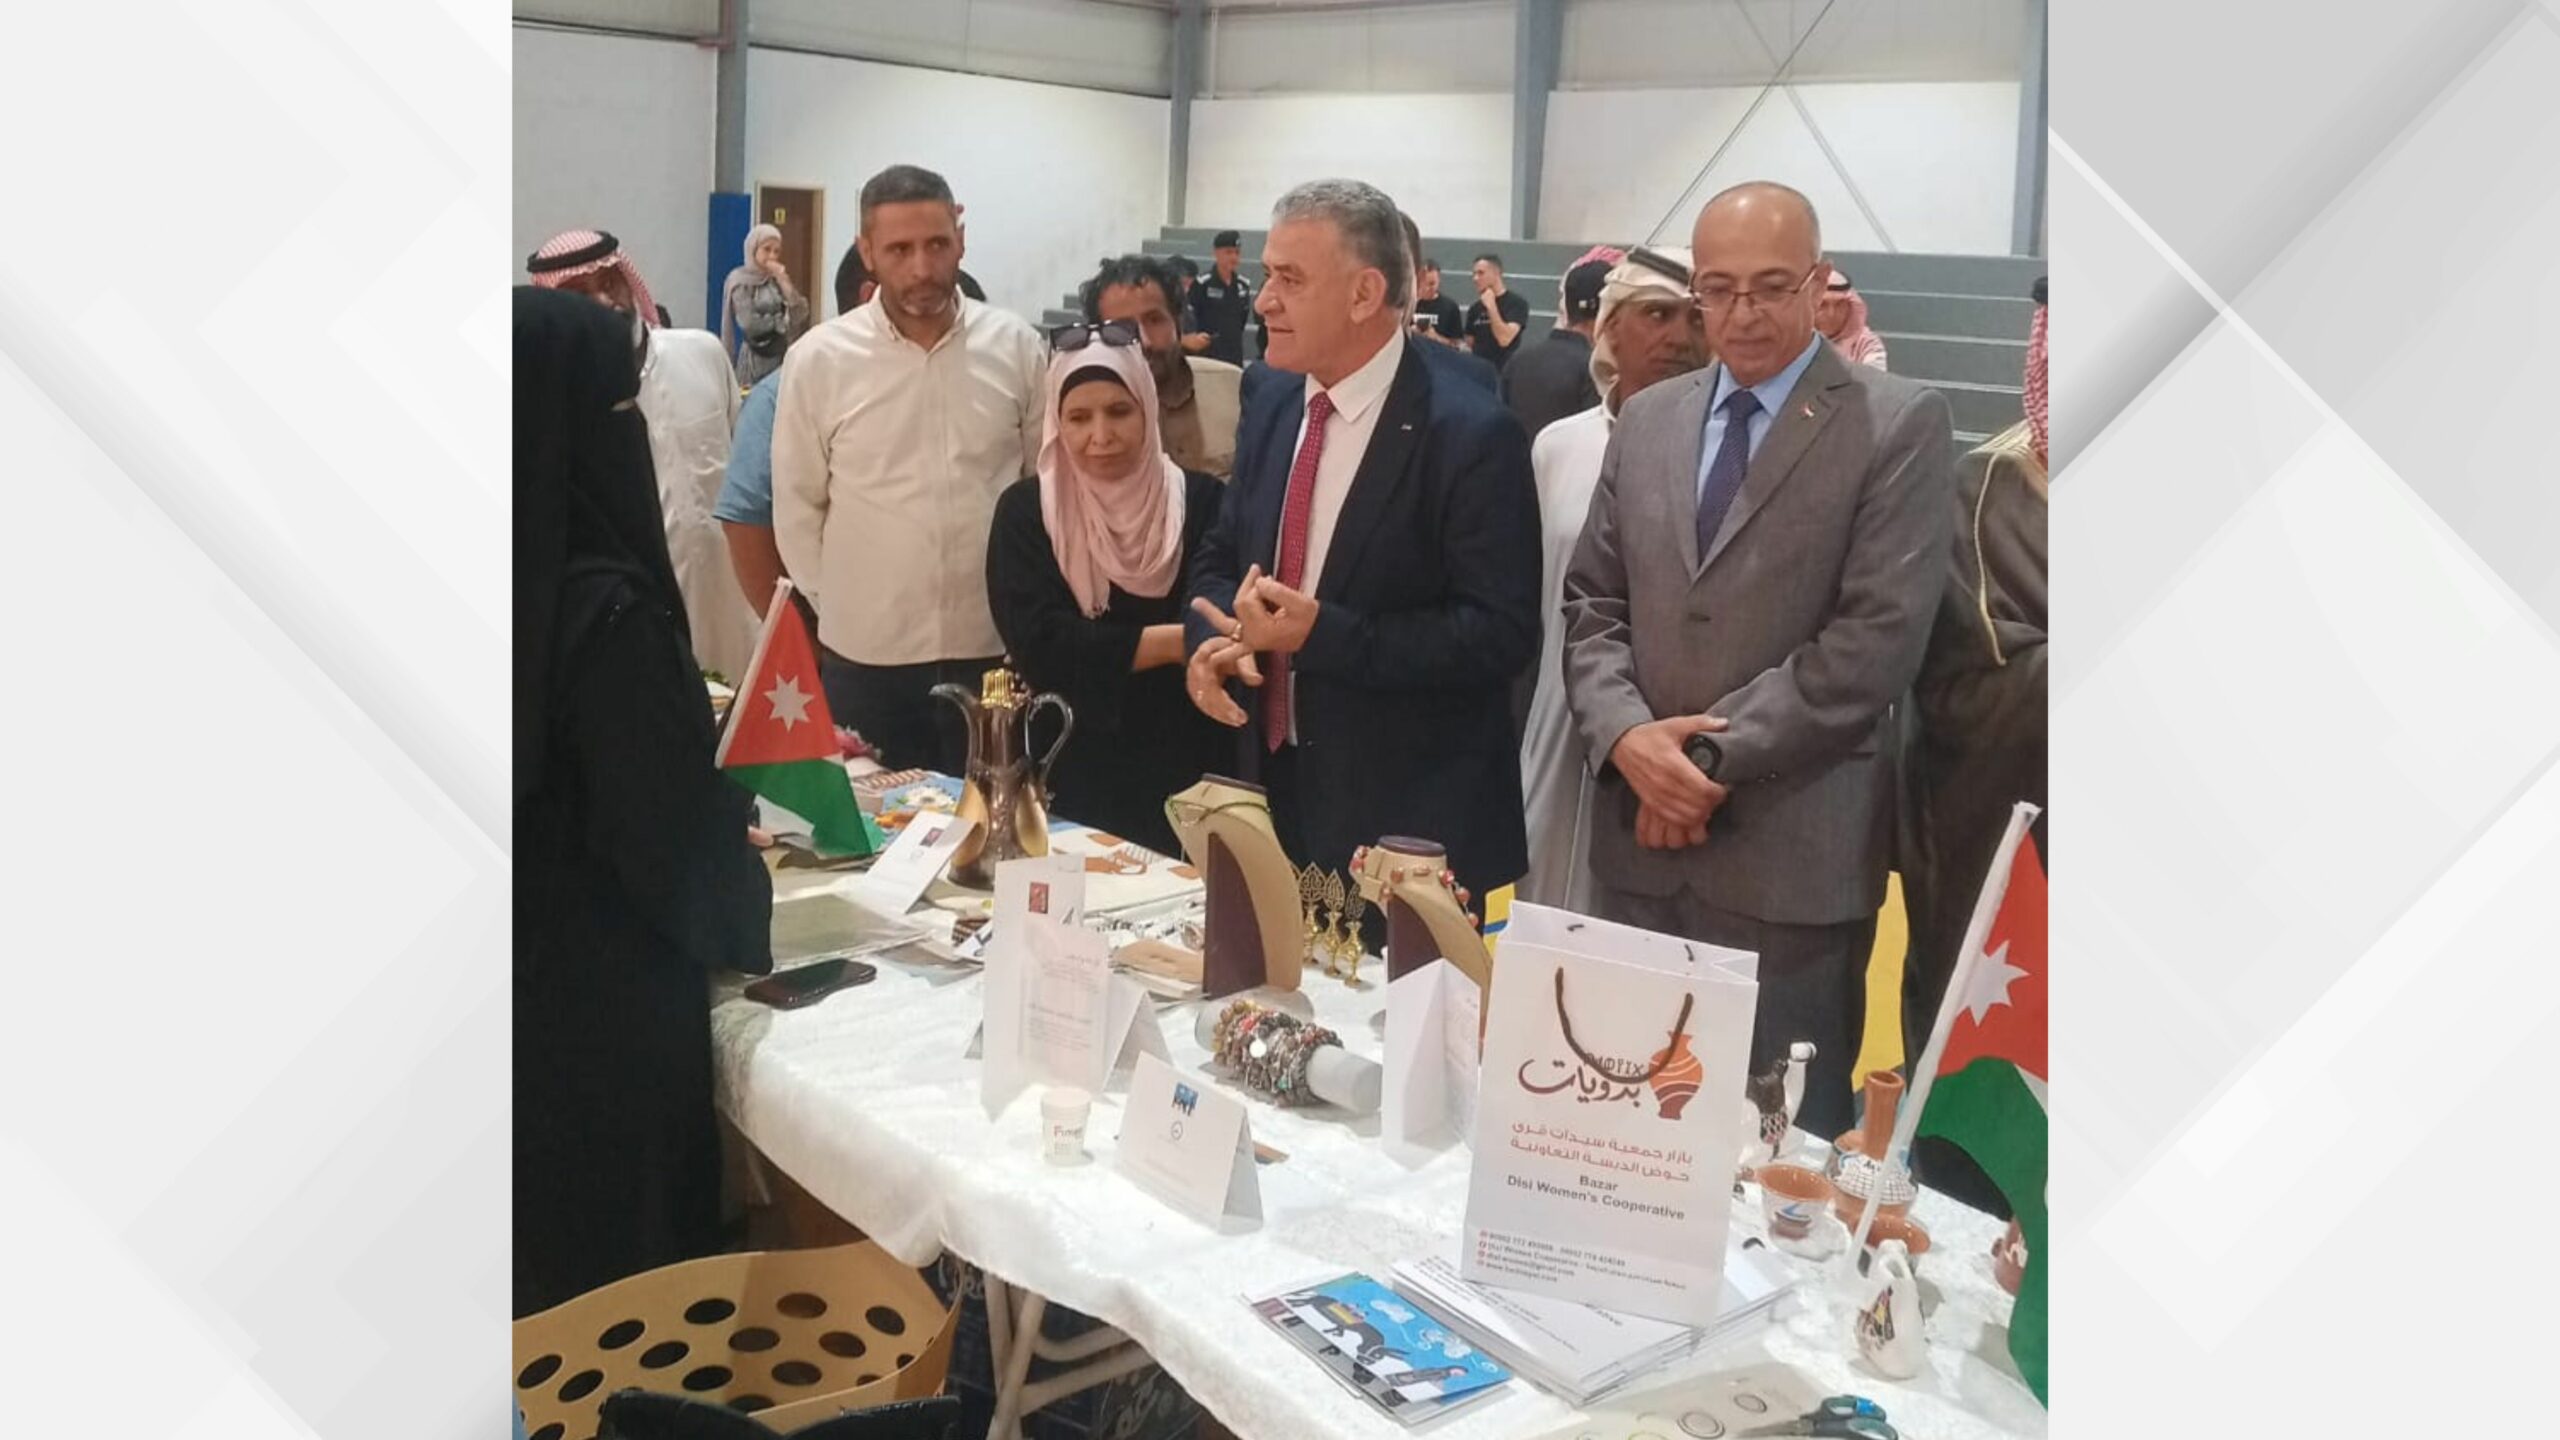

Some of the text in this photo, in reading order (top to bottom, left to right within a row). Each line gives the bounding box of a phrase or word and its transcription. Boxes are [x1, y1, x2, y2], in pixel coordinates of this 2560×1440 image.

[1518, 1059, 1640, 1107] بدويات
[1549, 1129, 1605, 1148] سيدات
[1609, 1139, 1662, 1159] جمعية
[1579, 1175, 1619, 1192] Bazar
[1507, 1174, 1685, 1220] Disi Women's Cooperative
